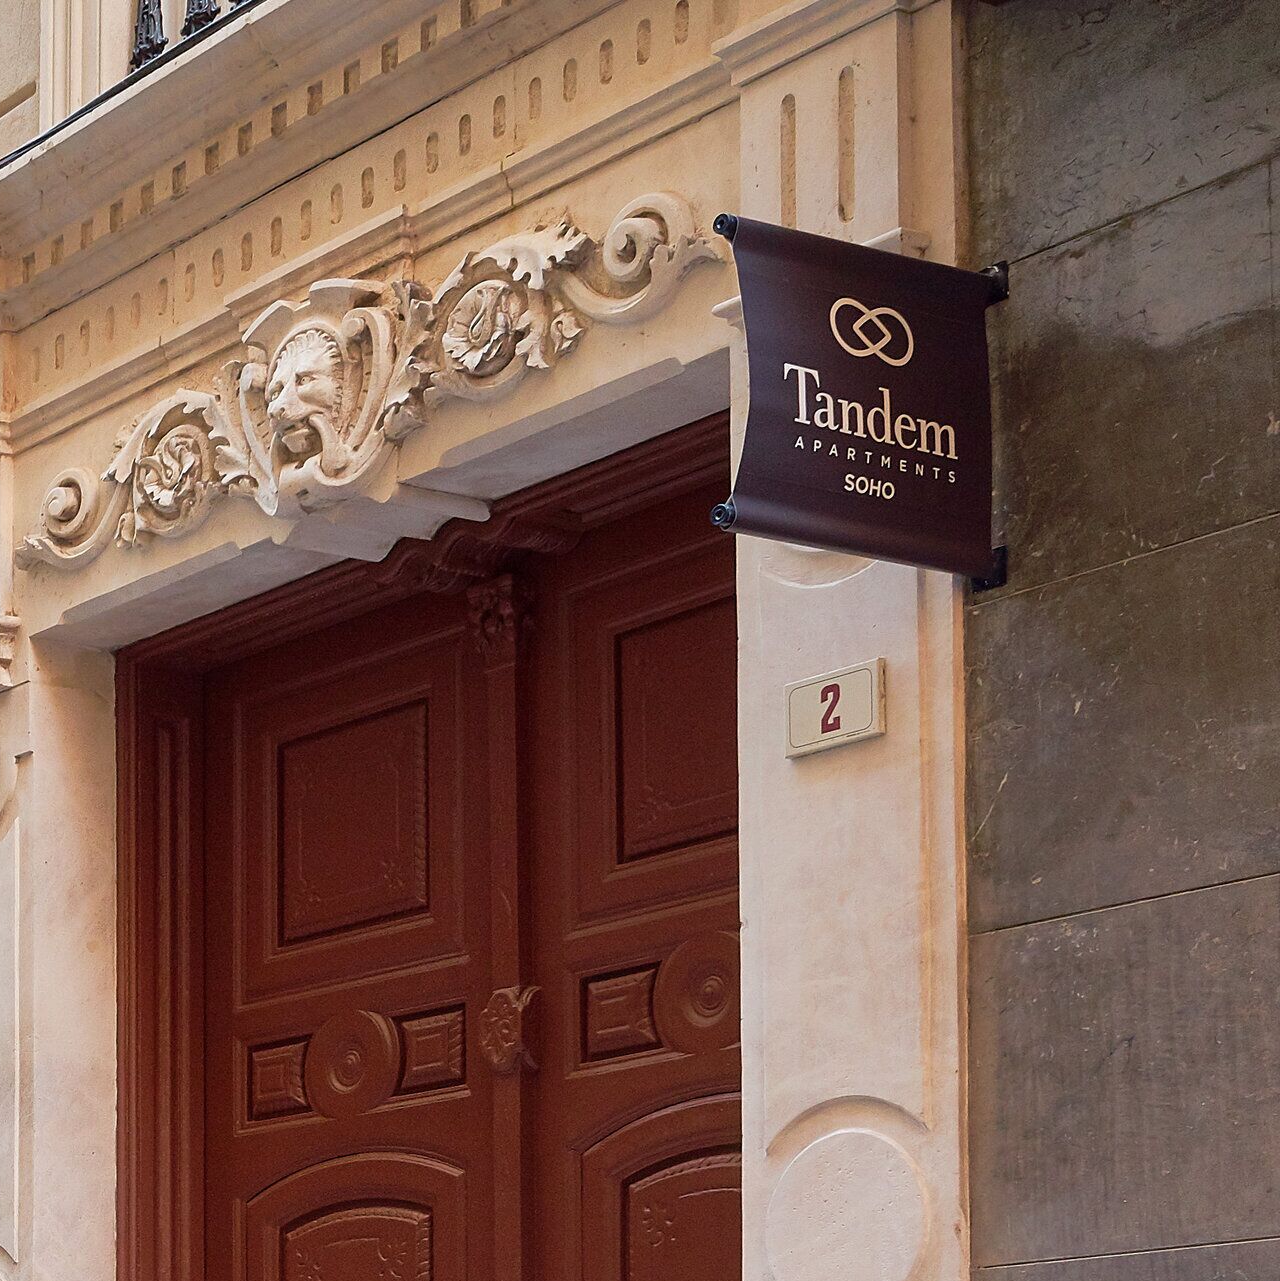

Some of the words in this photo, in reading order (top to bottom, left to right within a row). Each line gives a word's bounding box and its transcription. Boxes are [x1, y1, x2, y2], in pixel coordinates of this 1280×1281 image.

[783, 362, 959, 460] Tandem
[794, 436, 957, 484] APARTMENTS
[843, 473, 895, 500] SOHO
[820, 683, 841, 734] 2
